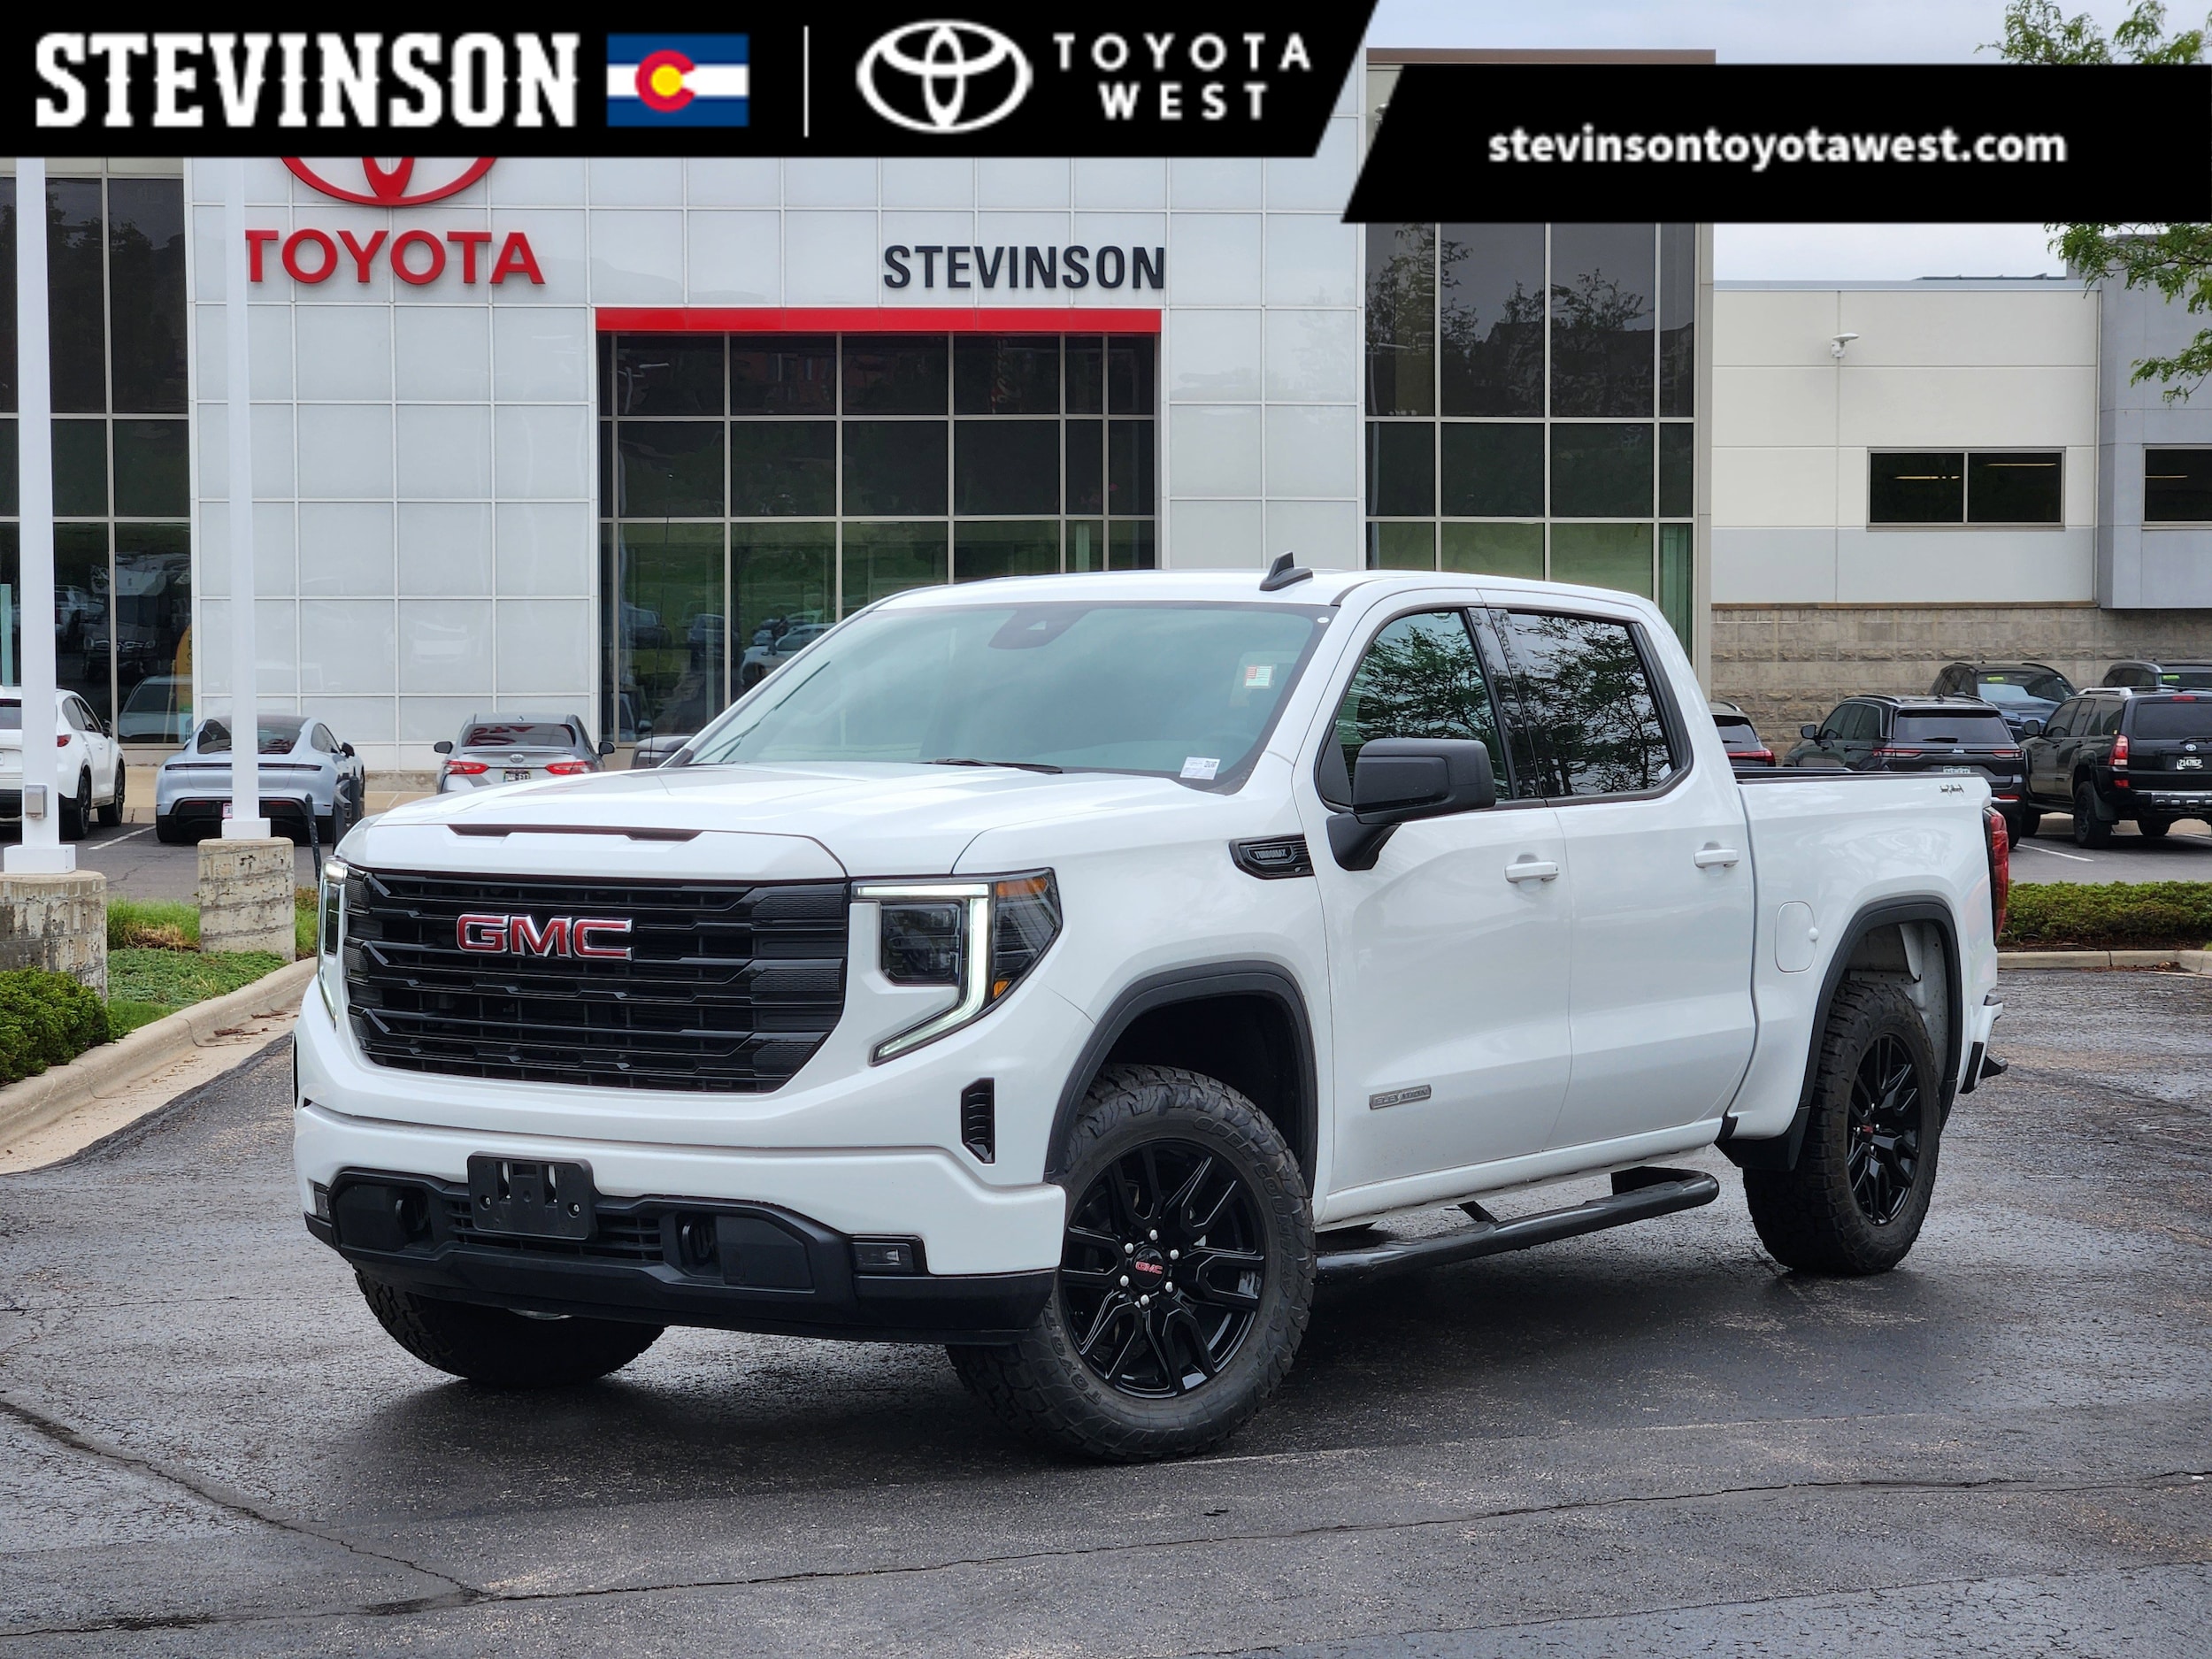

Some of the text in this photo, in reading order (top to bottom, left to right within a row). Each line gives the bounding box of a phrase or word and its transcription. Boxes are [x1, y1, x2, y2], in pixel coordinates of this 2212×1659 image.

[245, 228, 545, 286] TOYOTA
[884, 245, 1164, 289] STEVINSON
[456, 913, 633, 962] GMC
[1135, 1261, 1164, 1274] GMC
